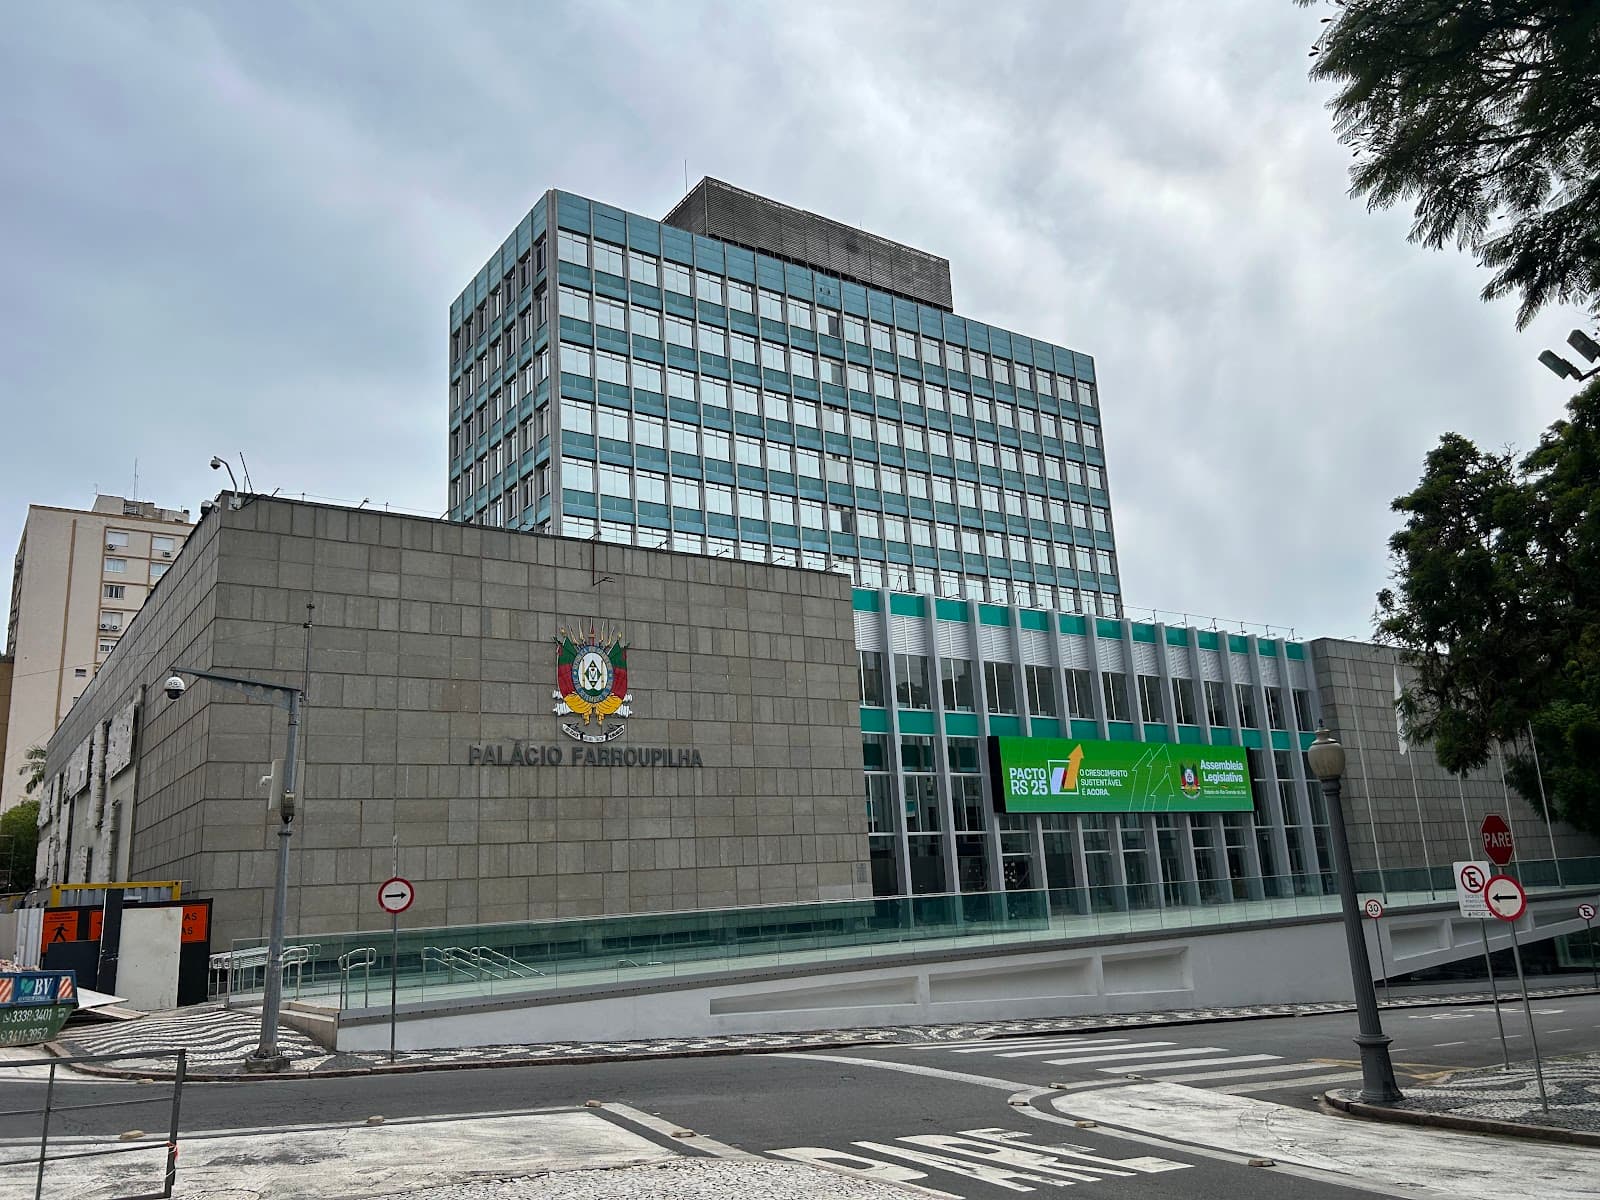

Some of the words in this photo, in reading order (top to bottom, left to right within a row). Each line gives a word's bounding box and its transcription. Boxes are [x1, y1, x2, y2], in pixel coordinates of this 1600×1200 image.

[469, 742, 563, 767] PALÁCIO
[571, 745, 703, 768] FARROUPILHA
[1200, 760, 1244, 770] Assembleia
[1009, 767, 1047, 780] PACTO
[1079, 769, 1085, 777] O
[1085, 769, 1128, 778] CRESCIMENTO
[1202, 771, 1244, 784] Legislativa
[1011, 780, 1029, 795] RS
[1031, 780, 1049, 795] 25
[1080, 777, 1122, 787] SUSTENTÁVEL
[1483, 833, 1511, 848] PARE
[1368, 903, 1379, 912] 30
[33, 978, 53, 995] BV
[763, 1127, 1195, 1192] PARE
